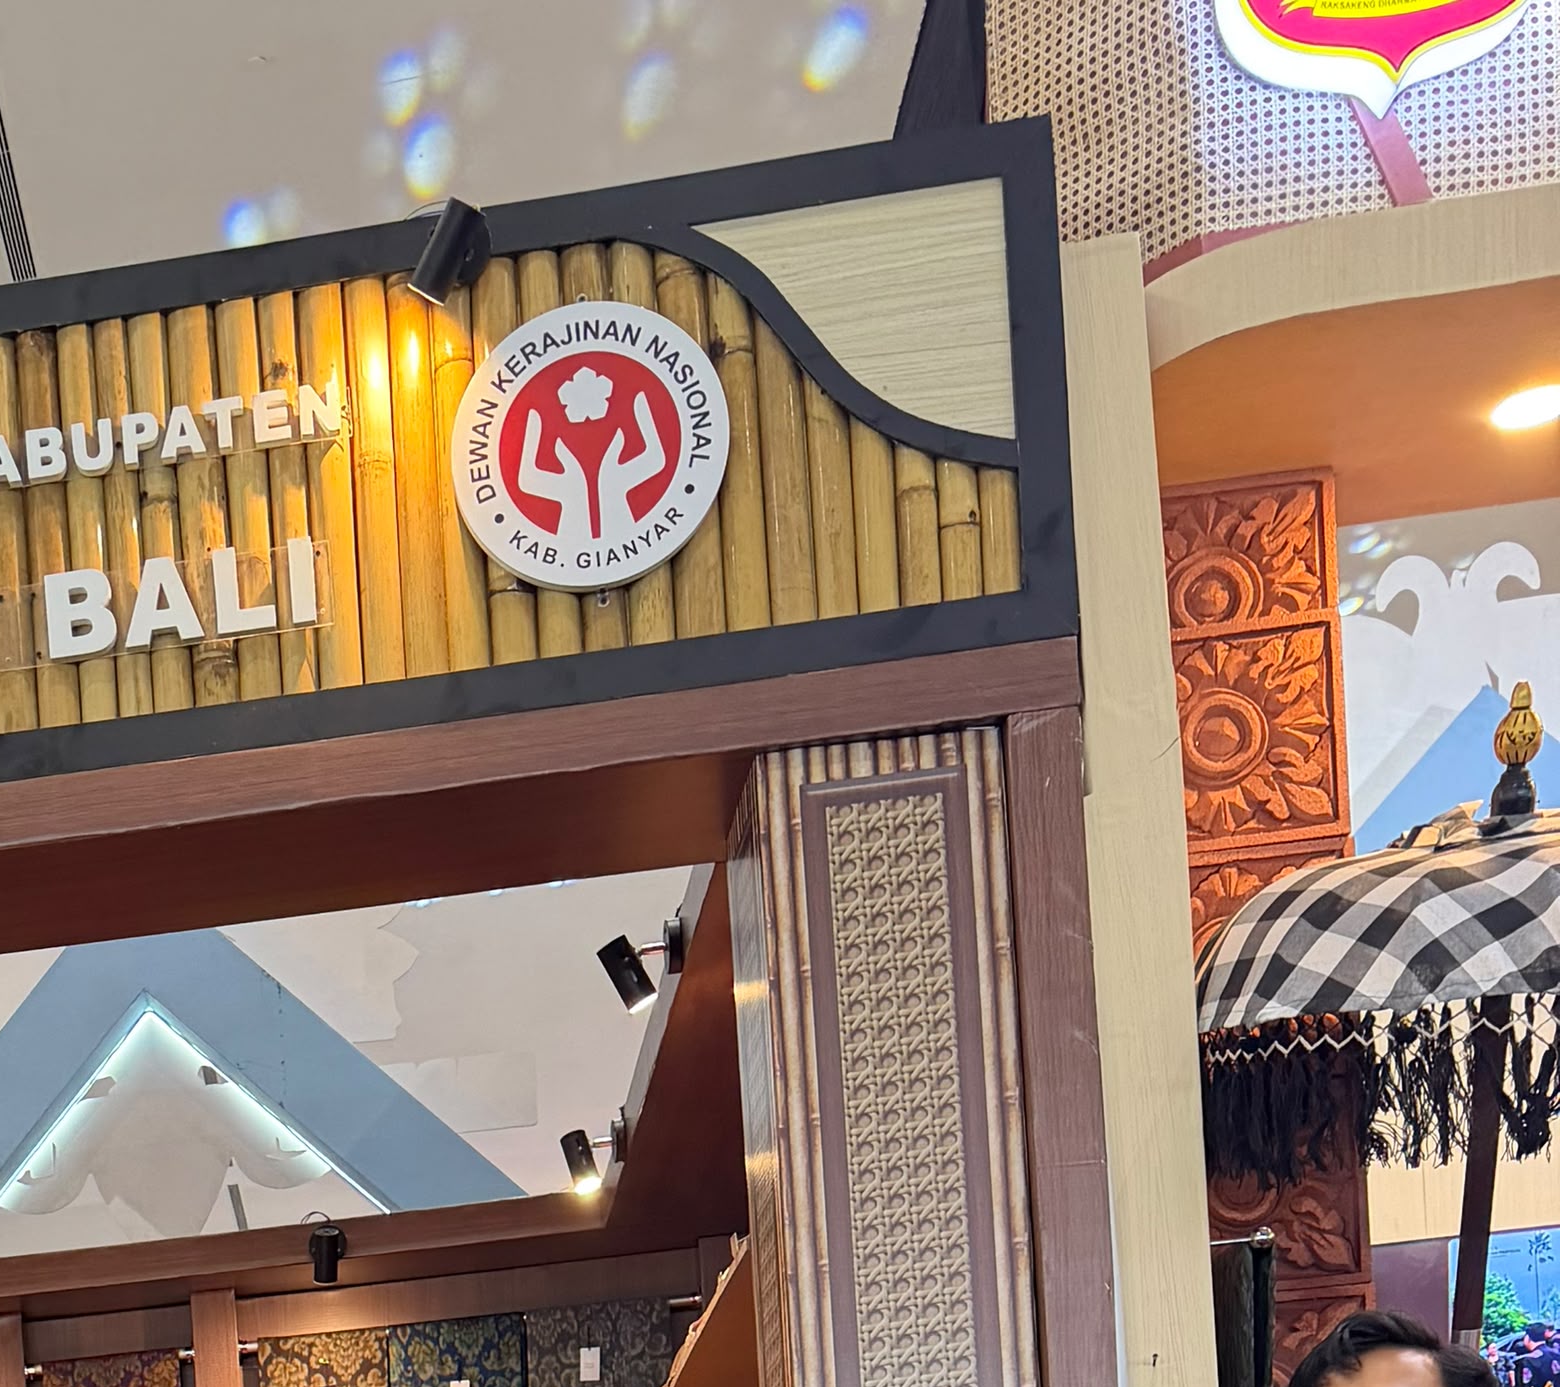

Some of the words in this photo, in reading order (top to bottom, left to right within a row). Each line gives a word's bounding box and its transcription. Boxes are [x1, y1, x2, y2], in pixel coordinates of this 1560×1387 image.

[469, 398, 499, 505] DEWAN
[490, 319, 642, 395] KERAJINAN
[645, 334, 713, 469] NASIONAL
[44, 535, 317, 660] BALI
[509, 529, 565, 567] KAB.
[576, 505, 684, 568] GIANYAR
